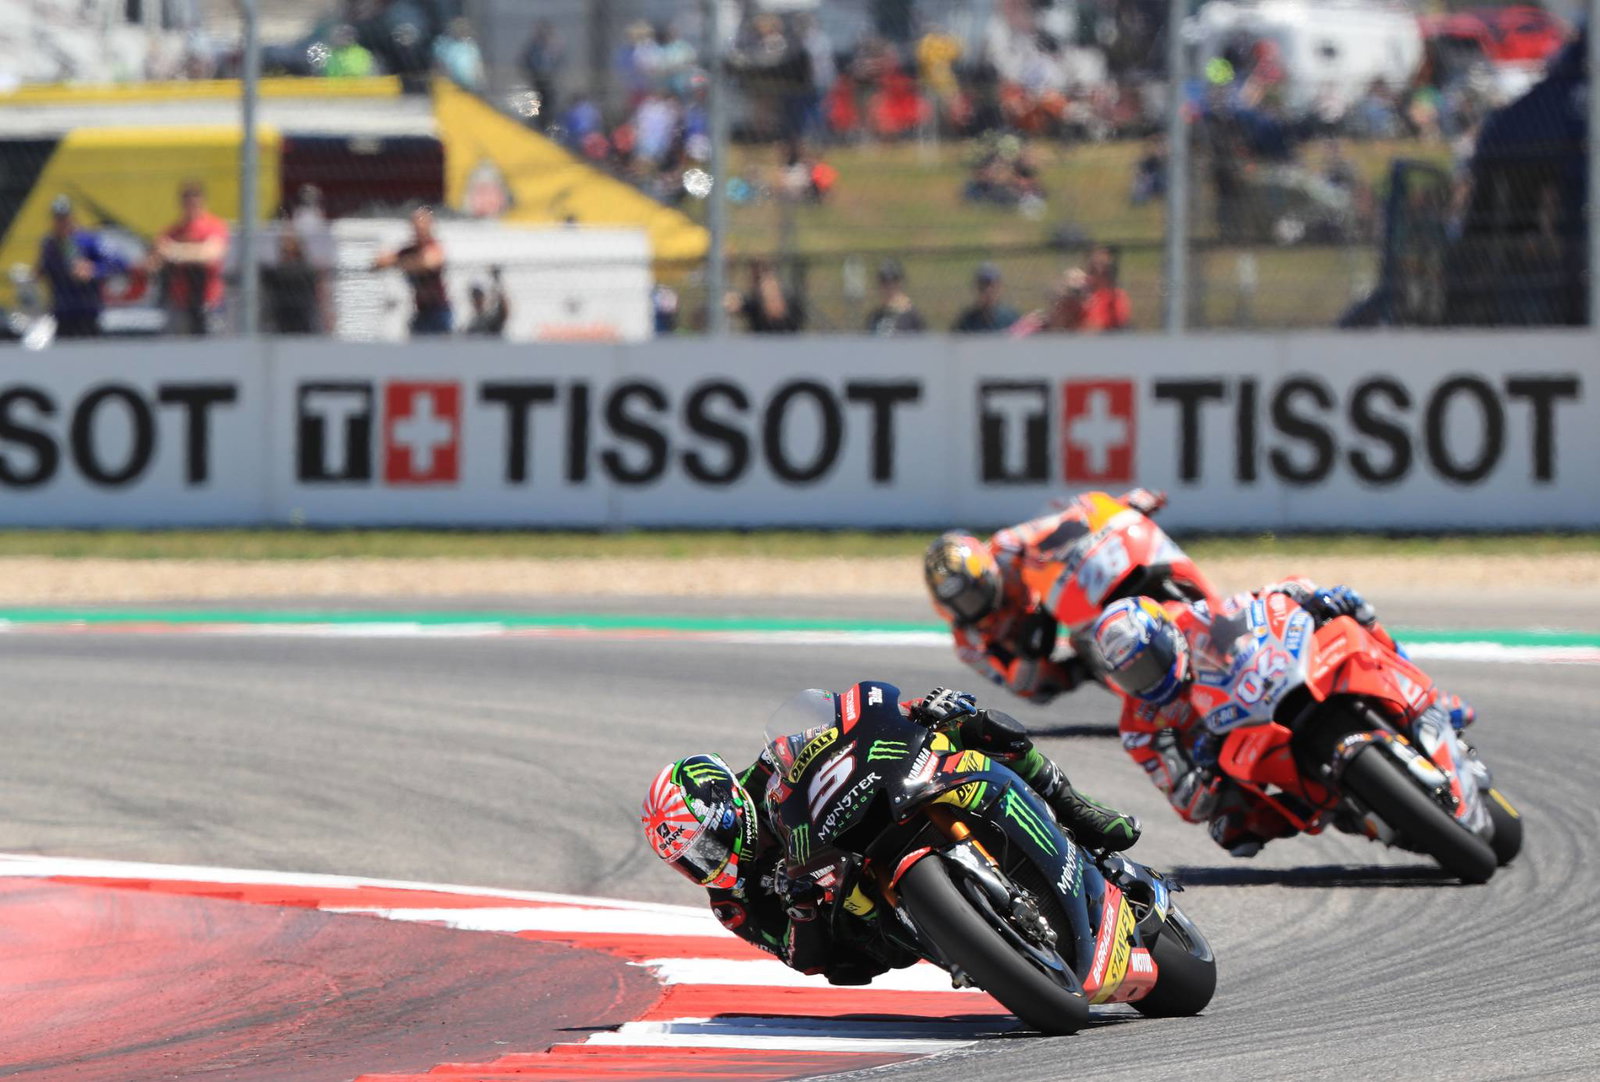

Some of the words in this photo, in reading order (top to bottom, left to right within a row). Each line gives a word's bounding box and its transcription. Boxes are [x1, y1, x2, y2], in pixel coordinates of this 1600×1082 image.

[0, 383, 238, 488] SOT
[480, 379, 923, 487] TISSOT
[1155, 375, 1581, 487] TISSOT
[1236, 647, 1289, 704] 04
[790, 732, 835, 779] DEWALT
[806, 741, 858, 822] 5
[907, 747, 931, 783] YAMAHA
[660, 825, 686, 851] SHARK
[818, 772, 882, 841] MONSTER
